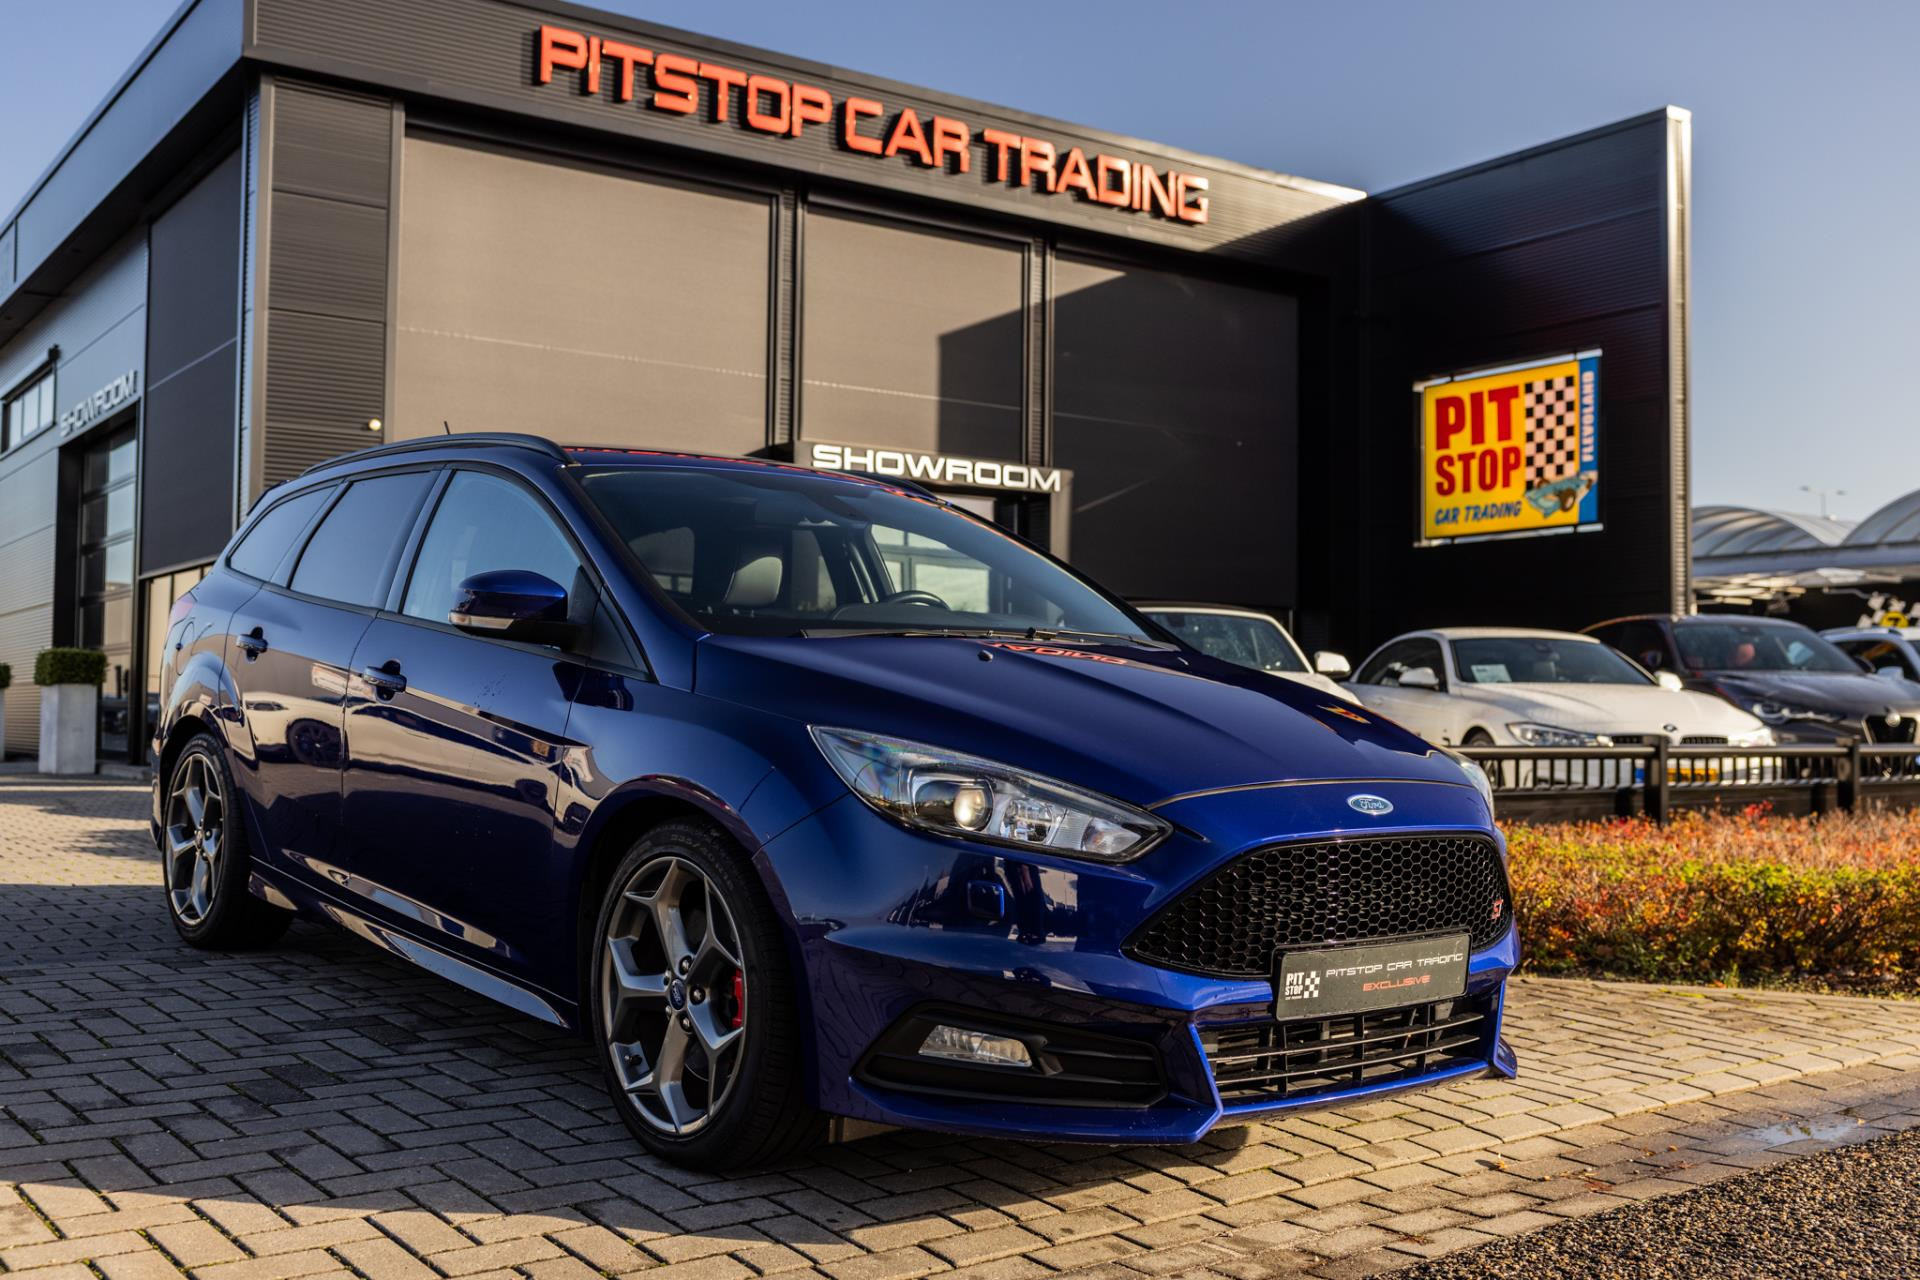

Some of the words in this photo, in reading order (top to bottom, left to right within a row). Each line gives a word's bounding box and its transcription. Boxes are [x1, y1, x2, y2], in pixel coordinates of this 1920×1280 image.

[540, 25, 832, 137] PITSTOP
[845, 99, 970, 173] CAR
[982, 129, 1211, 224] TRADING
[59, 369, 138, 437] SHOWROOM
[1435, 385, 1520, 450] PIT
[812, 444, 1061, 492] SHOWROOM
[1435, 445, 1521, 497] STOP
[1435, 507, 1460, 525] CAR
[1465, 501, 1522, 523] TRADING
[1285, 972, 1305, 986] PIT
[1325, 963, 1383, 978] PITSTOP
[1387, 959, 1413, 972] CAR
[1417, 953, 1464, 967] TRADING
[1362, 974, 1431, 992] EXCLUSIVE
[1284, 984, 1304, 996] STOP
